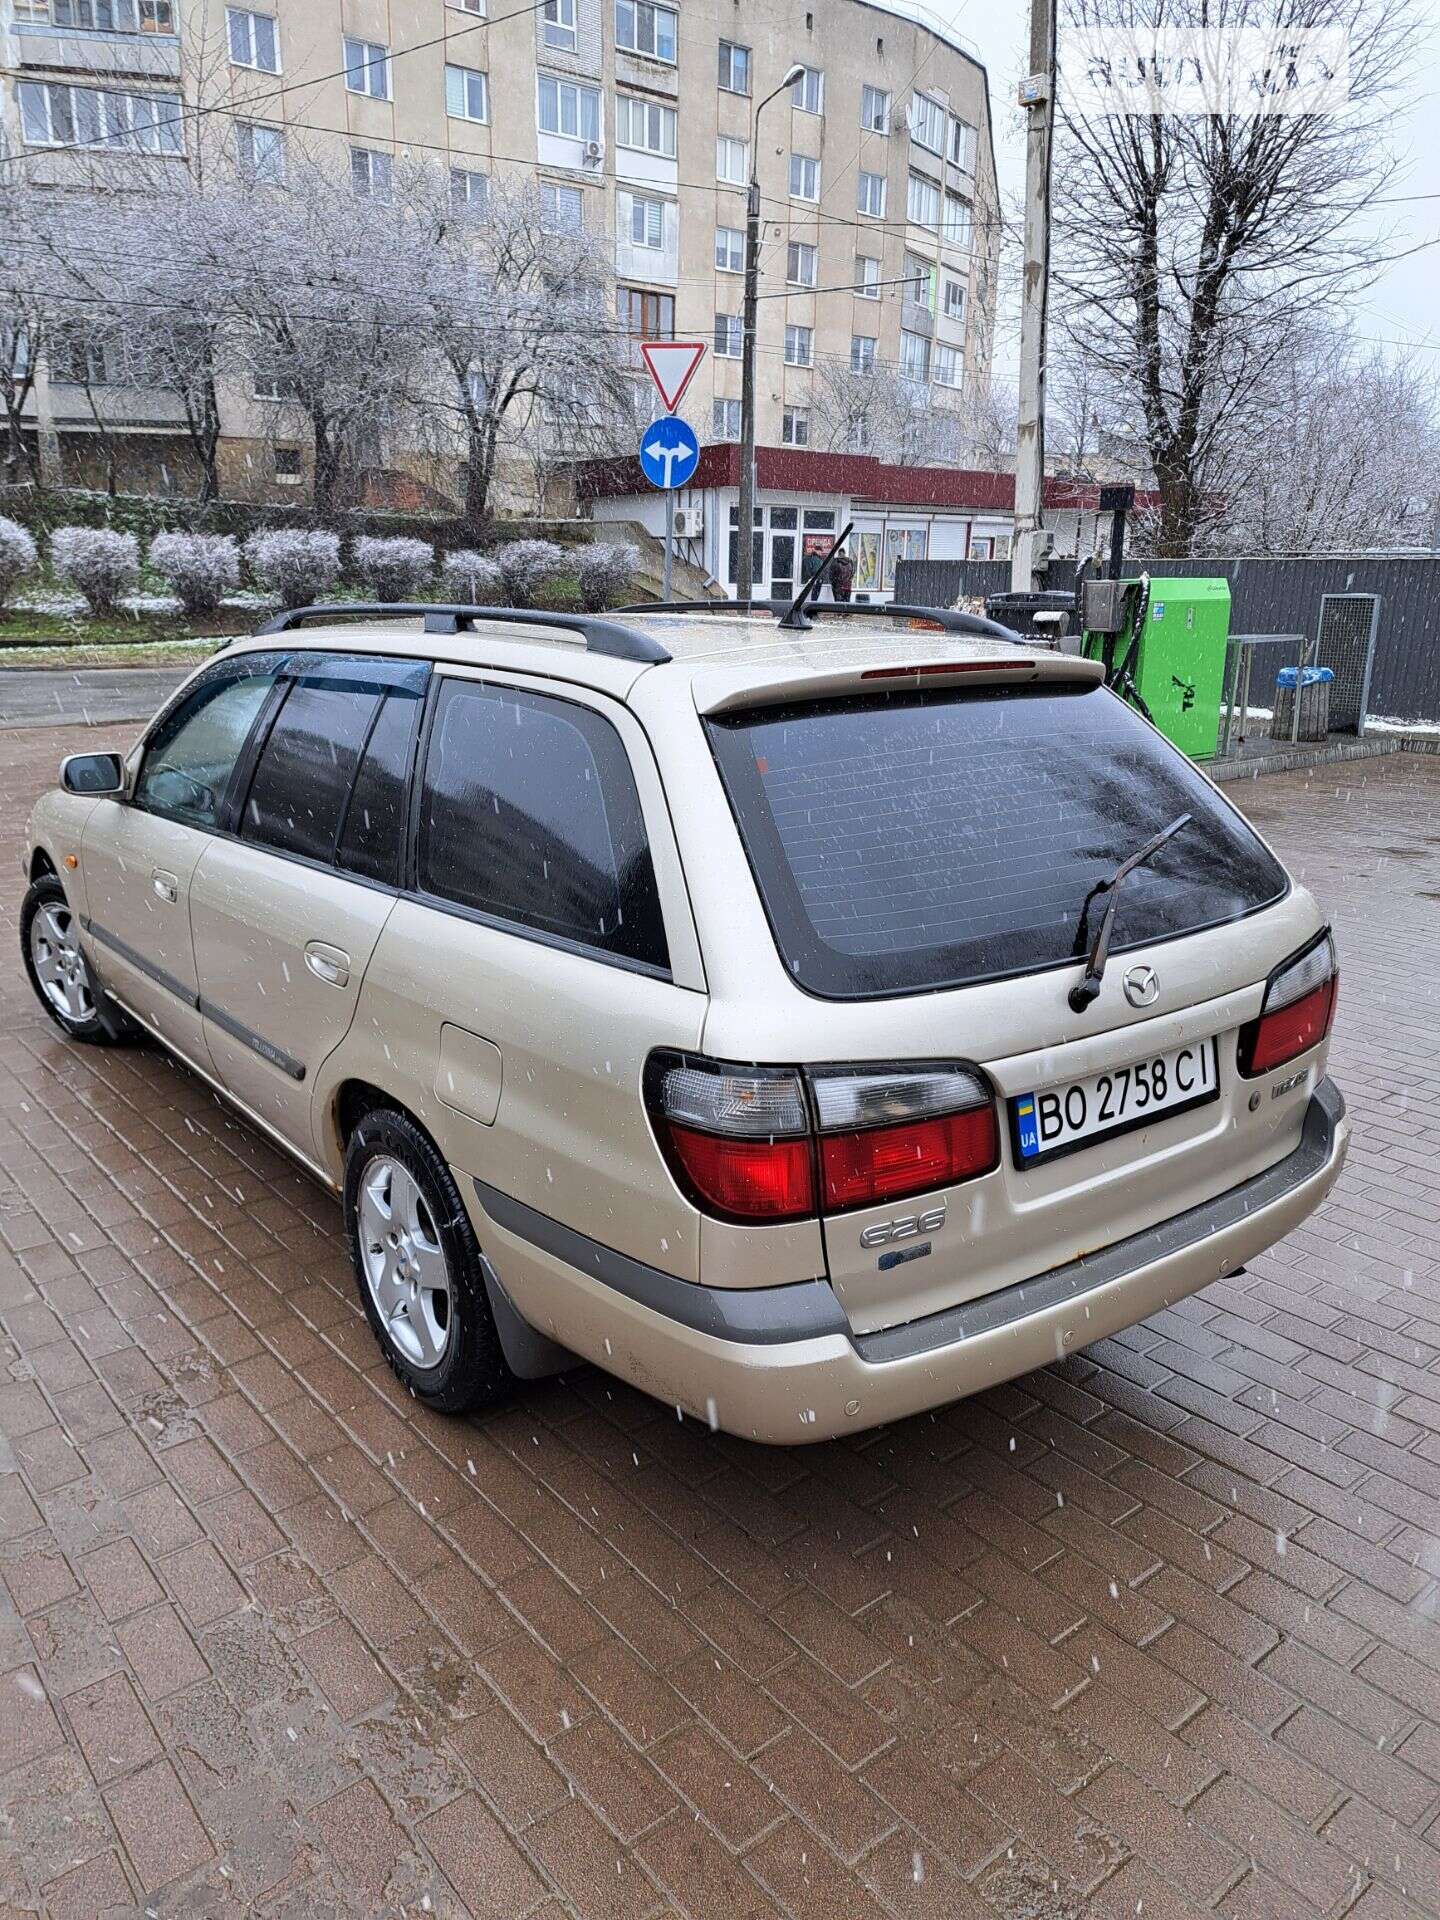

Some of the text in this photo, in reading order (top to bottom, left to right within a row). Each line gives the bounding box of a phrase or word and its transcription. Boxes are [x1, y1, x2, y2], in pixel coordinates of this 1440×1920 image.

[1038, 1044, 1208, 1141] BO 2758 CI
[1020, 1133, 1036, 1148] UA
[860, 1207, 946, 1249] 626
